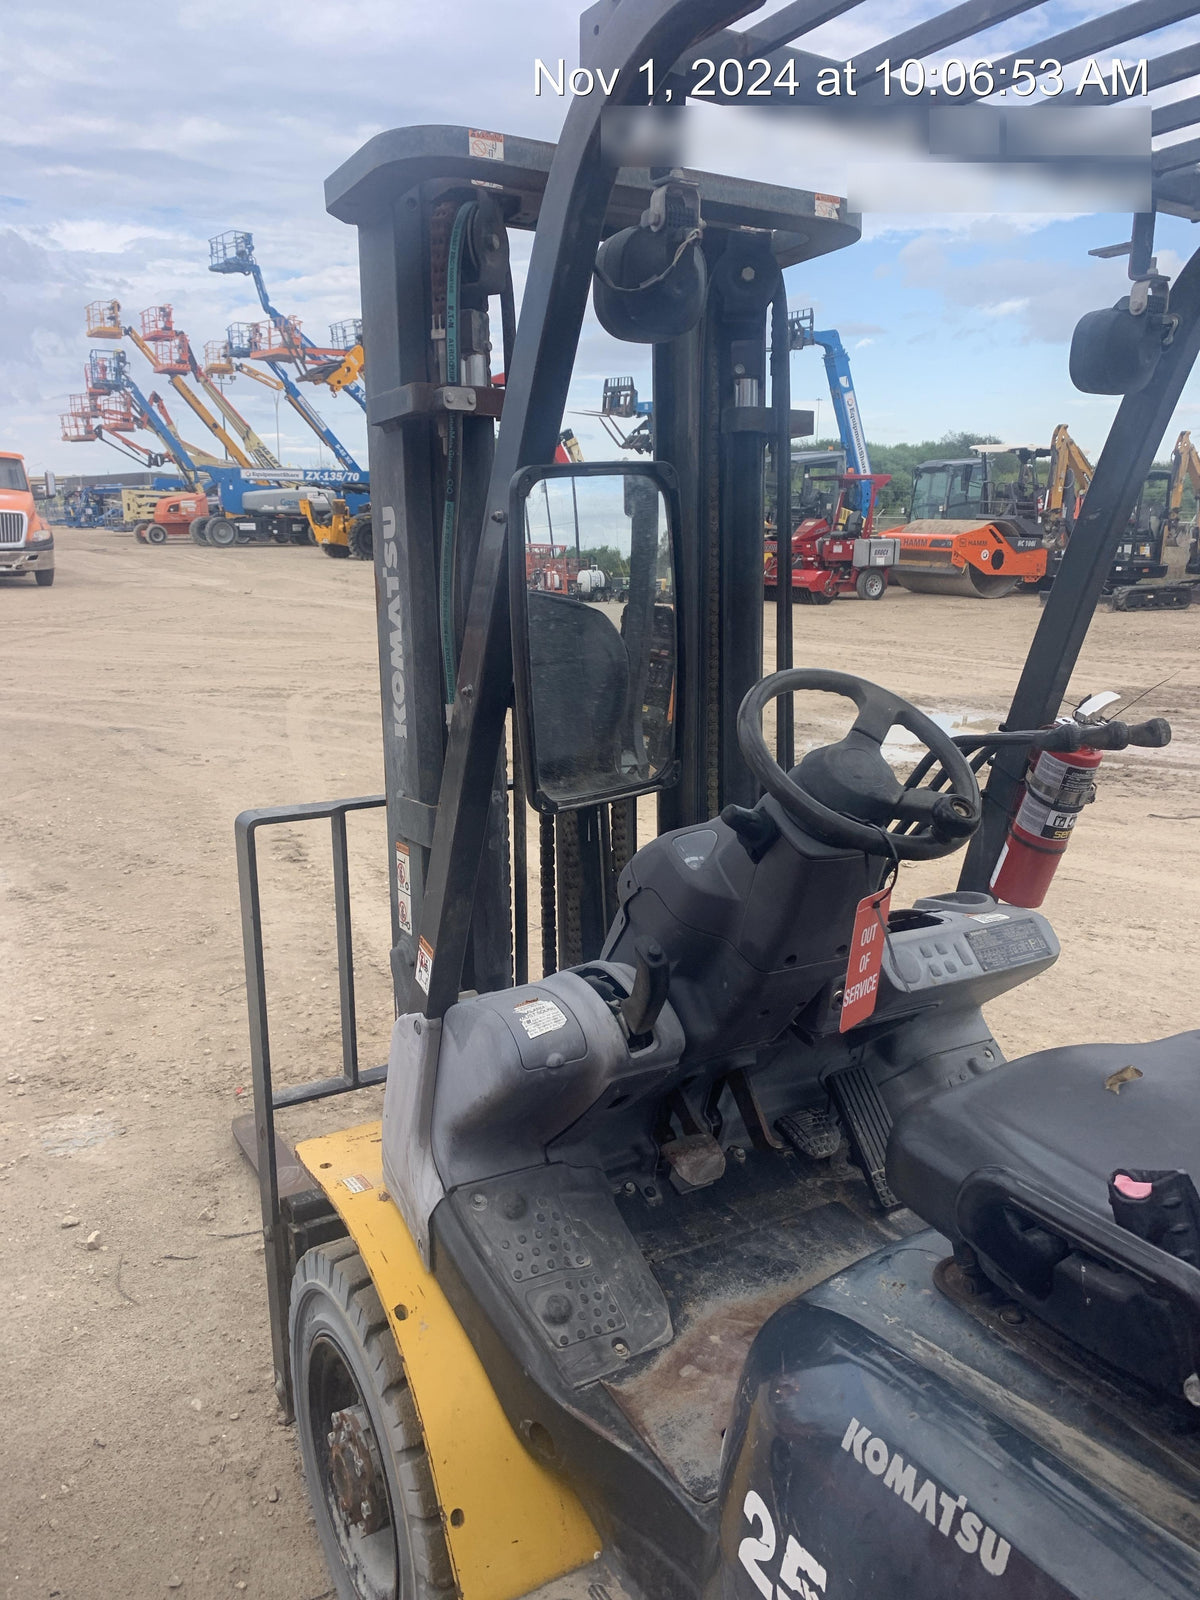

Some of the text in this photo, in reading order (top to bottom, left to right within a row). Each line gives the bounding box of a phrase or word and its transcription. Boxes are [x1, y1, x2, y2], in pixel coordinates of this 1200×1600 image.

[849, 407, 868, 474] EquipmentShare
[251, 470, 360, 481] EquipmentShare ZX-135/70
[903, 538, 928, 547] HAMM
[967, 539, 989, 547] HAMM
[381, 505, 408, 739] KOMATSU
[860, 922, 879, 947] OUT
[858, 951, 872, 974] OF
[842, 973, 879, 1008] SERVICE
[841, 1416, 1012, 1577] KOMATSU
